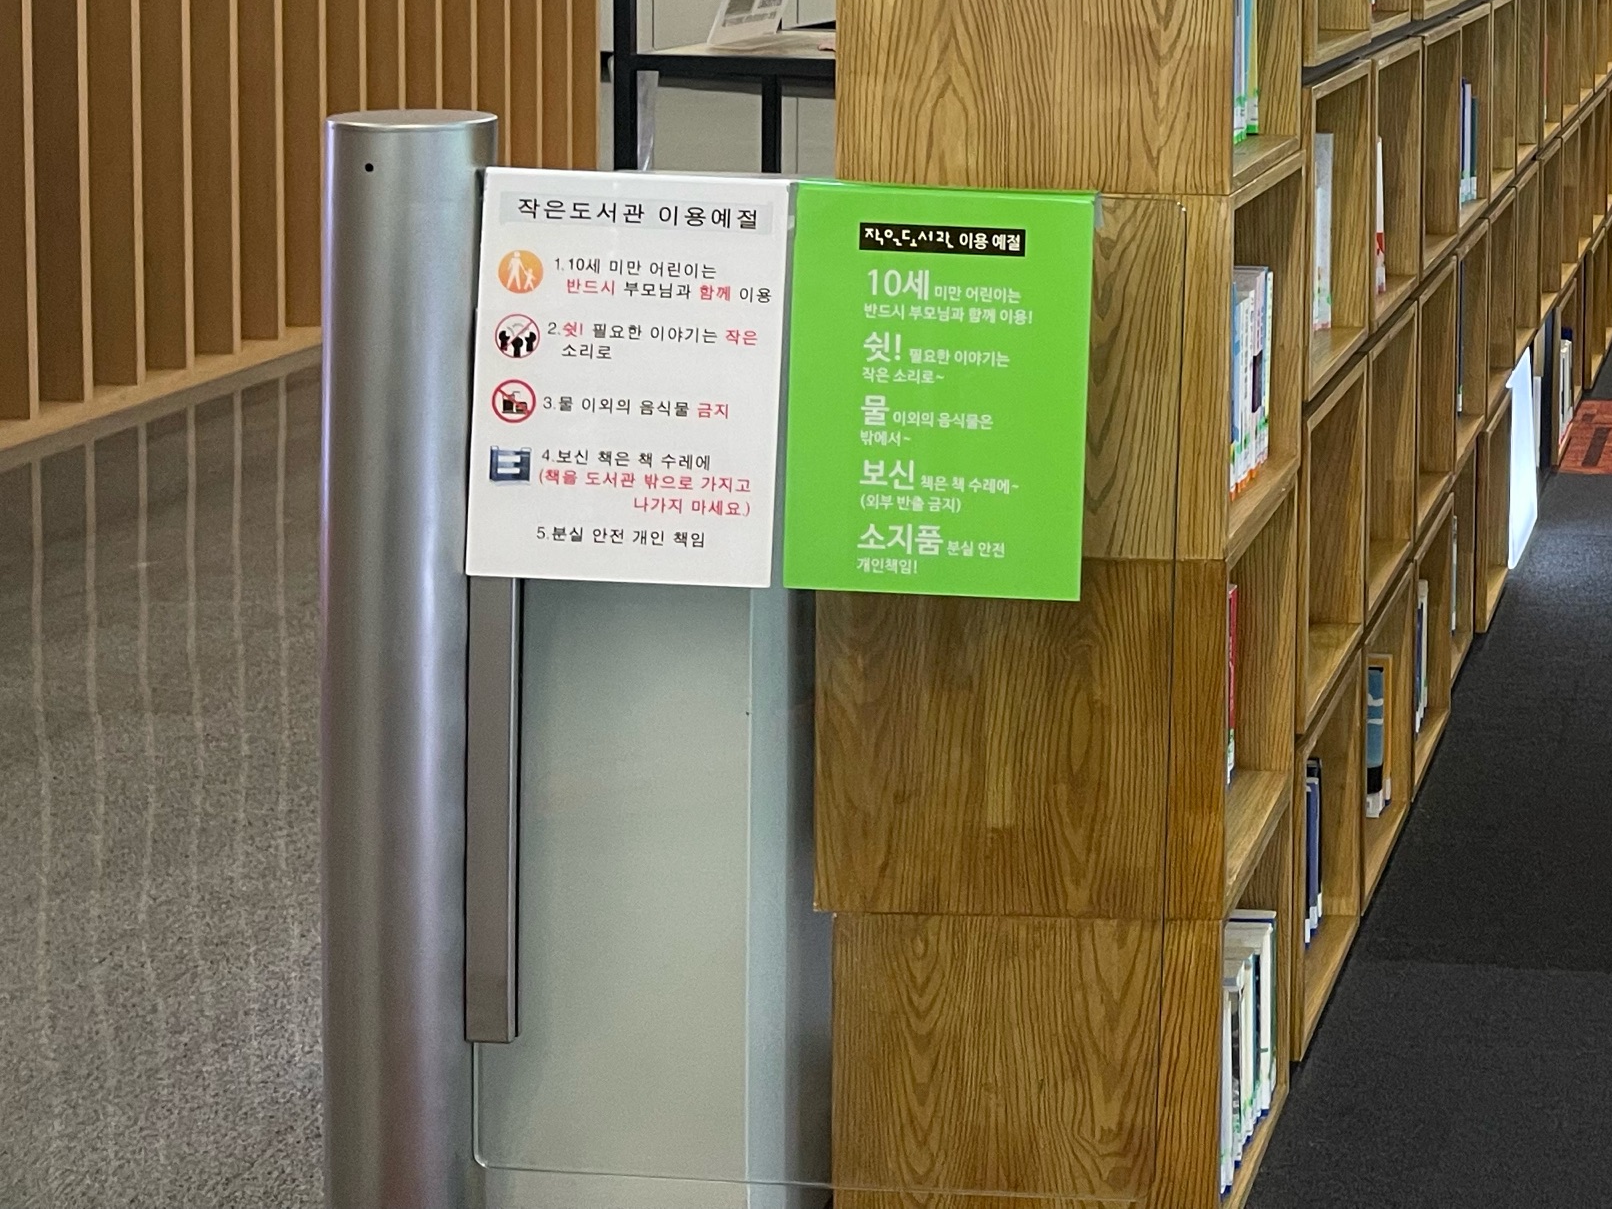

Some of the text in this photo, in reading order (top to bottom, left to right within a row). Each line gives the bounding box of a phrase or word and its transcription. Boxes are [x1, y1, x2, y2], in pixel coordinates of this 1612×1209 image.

[518, 199, 758, 229] 작은도서관 이용예절
[865, 227, 1020, 252] 작은도서관 이용 예절
[609, 260, 641, 275] 미만
[650, 262, 717, 279] 어린이는
[567, 279, 771, 303] 반드시 부모님과 함께 이용
[868, 269, 1021, 303] 10세 미만 어린이는
[864, 304, 1033, 325] 반드시 부모님과 함께 이용!
[593, 323, 642, 339] 필요한
[650, 326, 718, 344] 이야기는
[725, 328, 758, 345] 작은
[562, 344, 612, 359] 소리로
[864, 332, 1009, 367] 쉿! 필요한 이야기는
[863, 367, 890, 383] 작은
[582, 398, 631, 414] 이외의
[640, 401, 689, 416] 음식물
[698, 403, 729, 419] 금지
[861, 396, 993, 430] 물 이외의 음식물은
[598, 450, 630, 466] 책은
[638, 453, 653, 467] 책
[661, 454, 711, 469] 수레에
[539, 469, 751, 493] (책을 도서관 밖으로 가지고
[860, 460, 914, 490] 보신
[921, 475, 948, 491] 책은
[952, 477, 965, 492] 책
[634, 498, 683, 514] 나가지
[860, 495, 961, 513] (외부 반출 금지)
[593, 528, 625, 544] 안전
[633, 530, 664, 546] 개인
[673, 531, 705, 548] 책임
[857, 523, 1005, 557] 소지품 분실 안전
[856, 558, 918, 574] 개인책임!
